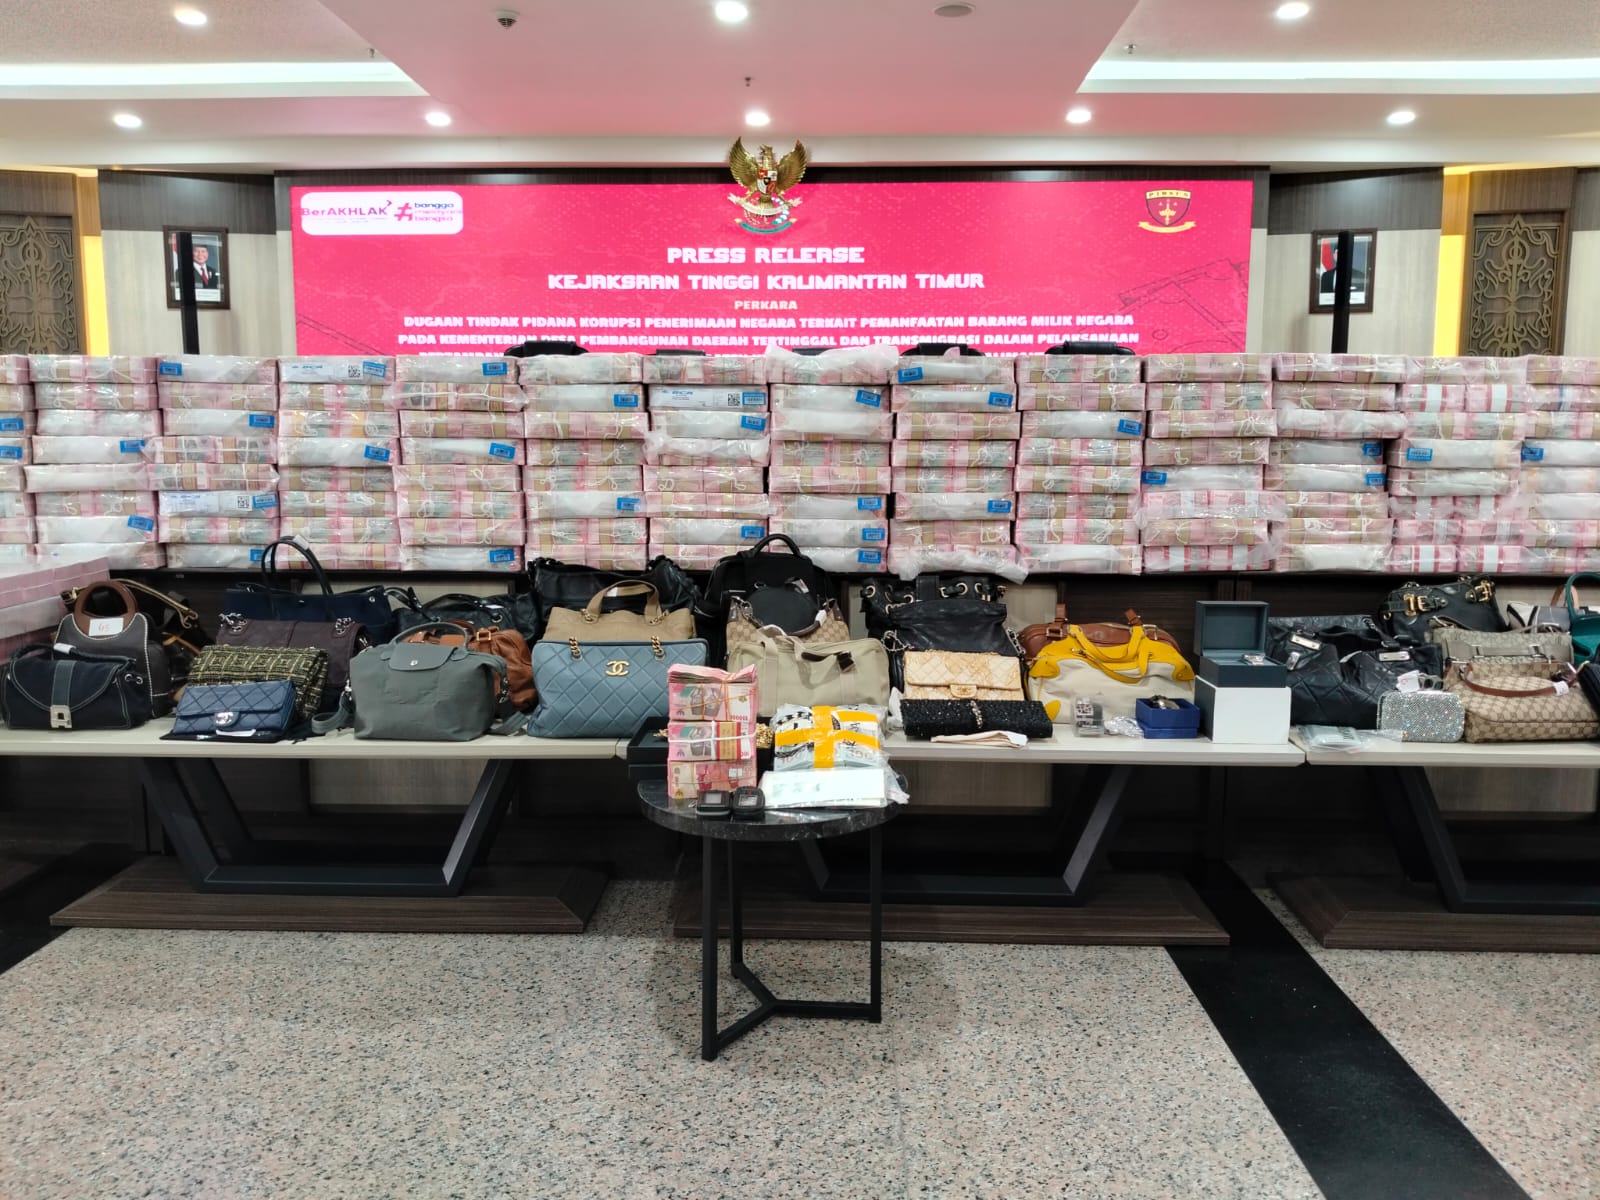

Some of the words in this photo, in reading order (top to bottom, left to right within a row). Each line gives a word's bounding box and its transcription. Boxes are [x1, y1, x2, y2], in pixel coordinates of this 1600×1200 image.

[301, 207, 388, 216] BerAKHLAK
[668, 247, 746, 263] PRESS
[755, 247, 865, 263] RELEASE
[548, 275, 679, 290] KEJAKSAAN
[688, 275, 759, 290] TINGGI
[767, 274, 907, 290] KALIMANTAN
[915, 274, 985, 289] TIMUR
[734, 301, 798, 310] PERKARA
[404, 316, 463, 327] DUGAAN
[466, 317, 519, 328] TINDAK
[522, 317, 576, 328] PIDANA
[580, 317, 641, 328] KORUPSI
[645, 317, 736, 328] PENERIMAAN
[740, 317, 796, 328] NEGARA
[799, 317, 857, 328] TERKAIT
[860, 316, 965, 328] PEMANFAATAN
[968, 316, 1027, 327] BARANG
[1031, 315, 1072, 326] MILIK
[1076, 315, 1134, 326] NEGARA
[398, 334, 436, 345] PADA
[439, 334, 537, 345] KEMENTERIAN
[580, 335, 688, 346] PEMBANGUNAN
[692, 336, 748, 346] DAERAH
[752, 336, 837, 346] TERTINGGAL
[840, 335, 871, 345] DAN
[873, 334, 980, 345] TRANSMIGRASI
[984, 334, 1034, 345] DALAM
[1038, 333, 1139, 344] PELAKSANAAN
